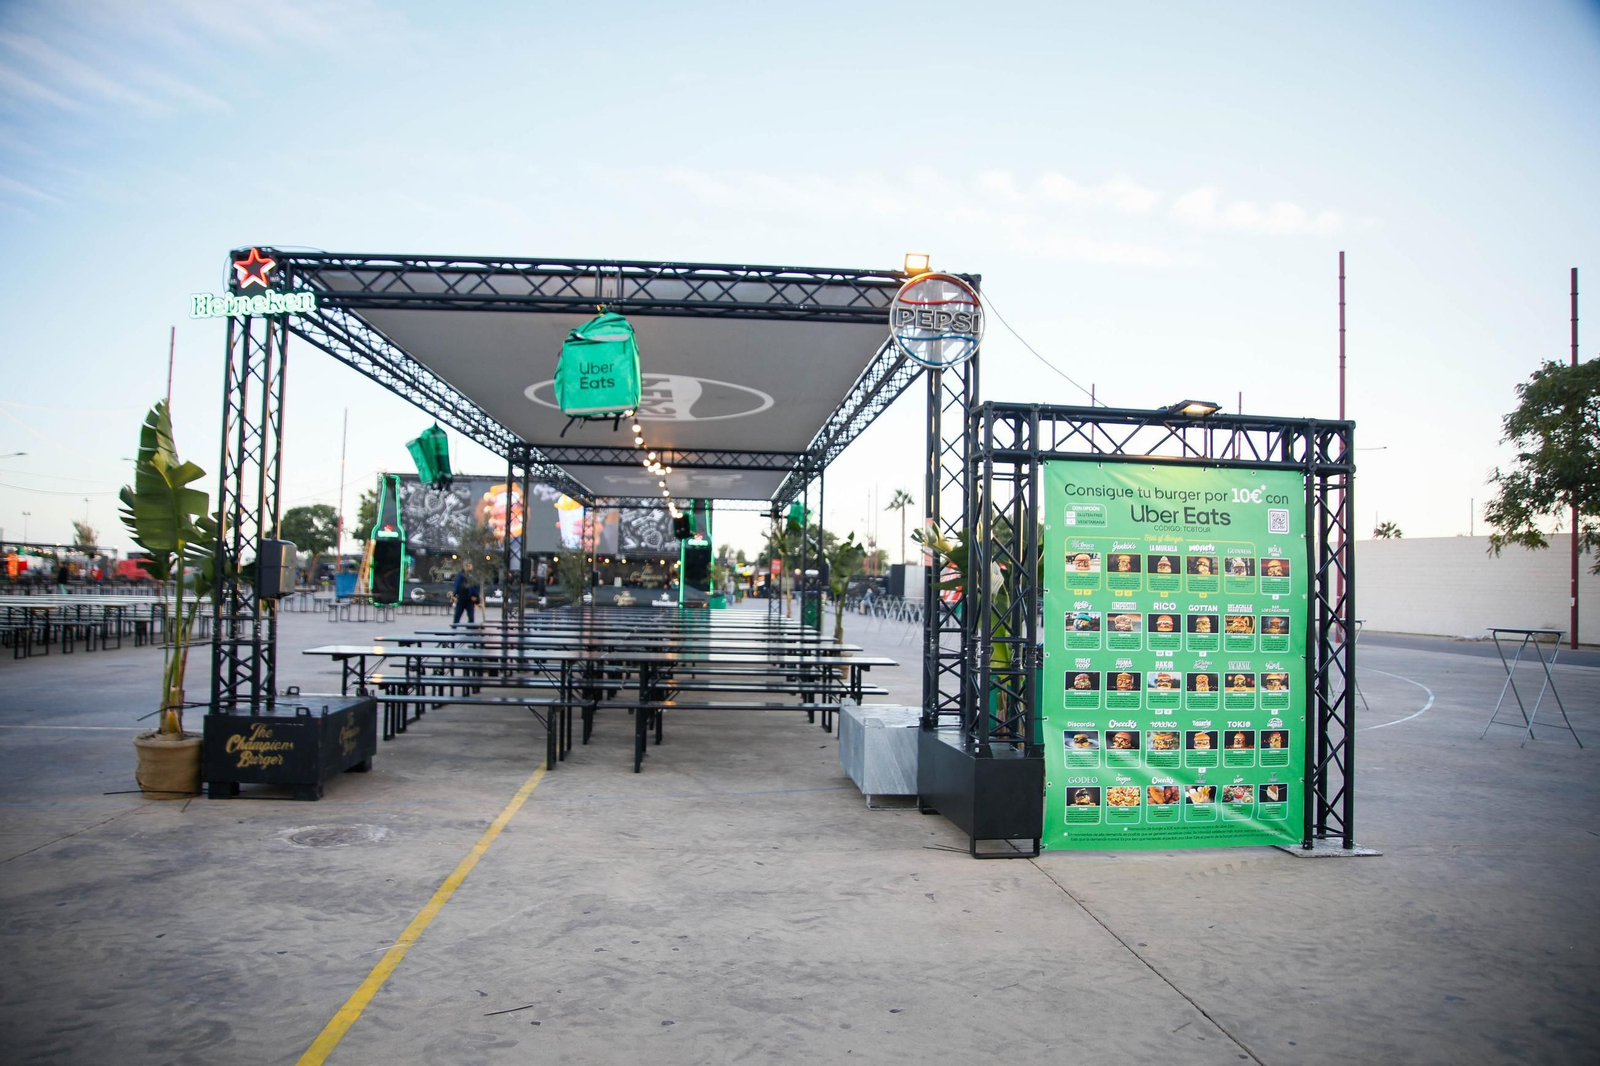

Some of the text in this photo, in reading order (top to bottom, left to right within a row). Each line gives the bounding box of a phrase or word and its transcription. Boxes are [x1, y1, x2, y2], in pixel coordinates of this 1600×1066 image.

[189, 289, 317, 319] Heineken
[895, 306, 981, 334] PEPSI
[579, 361, 615, 375] Uber
[580, 376, 615, 390] Eats
[1064, 483, 1134, 500] Consigue
[1137, 487, 1151, 499] tu
[1155, 487, 1201, 503] burger
[1205, 490, 1228, 504] por
[1266, 493, 1289, 504] con
[1130, 504, 1232, 526] Uber Eats
[250, 722, 273, 741] The
[226, 734, 294, 754] Champions
[236, 751, 284, 770] Burger
